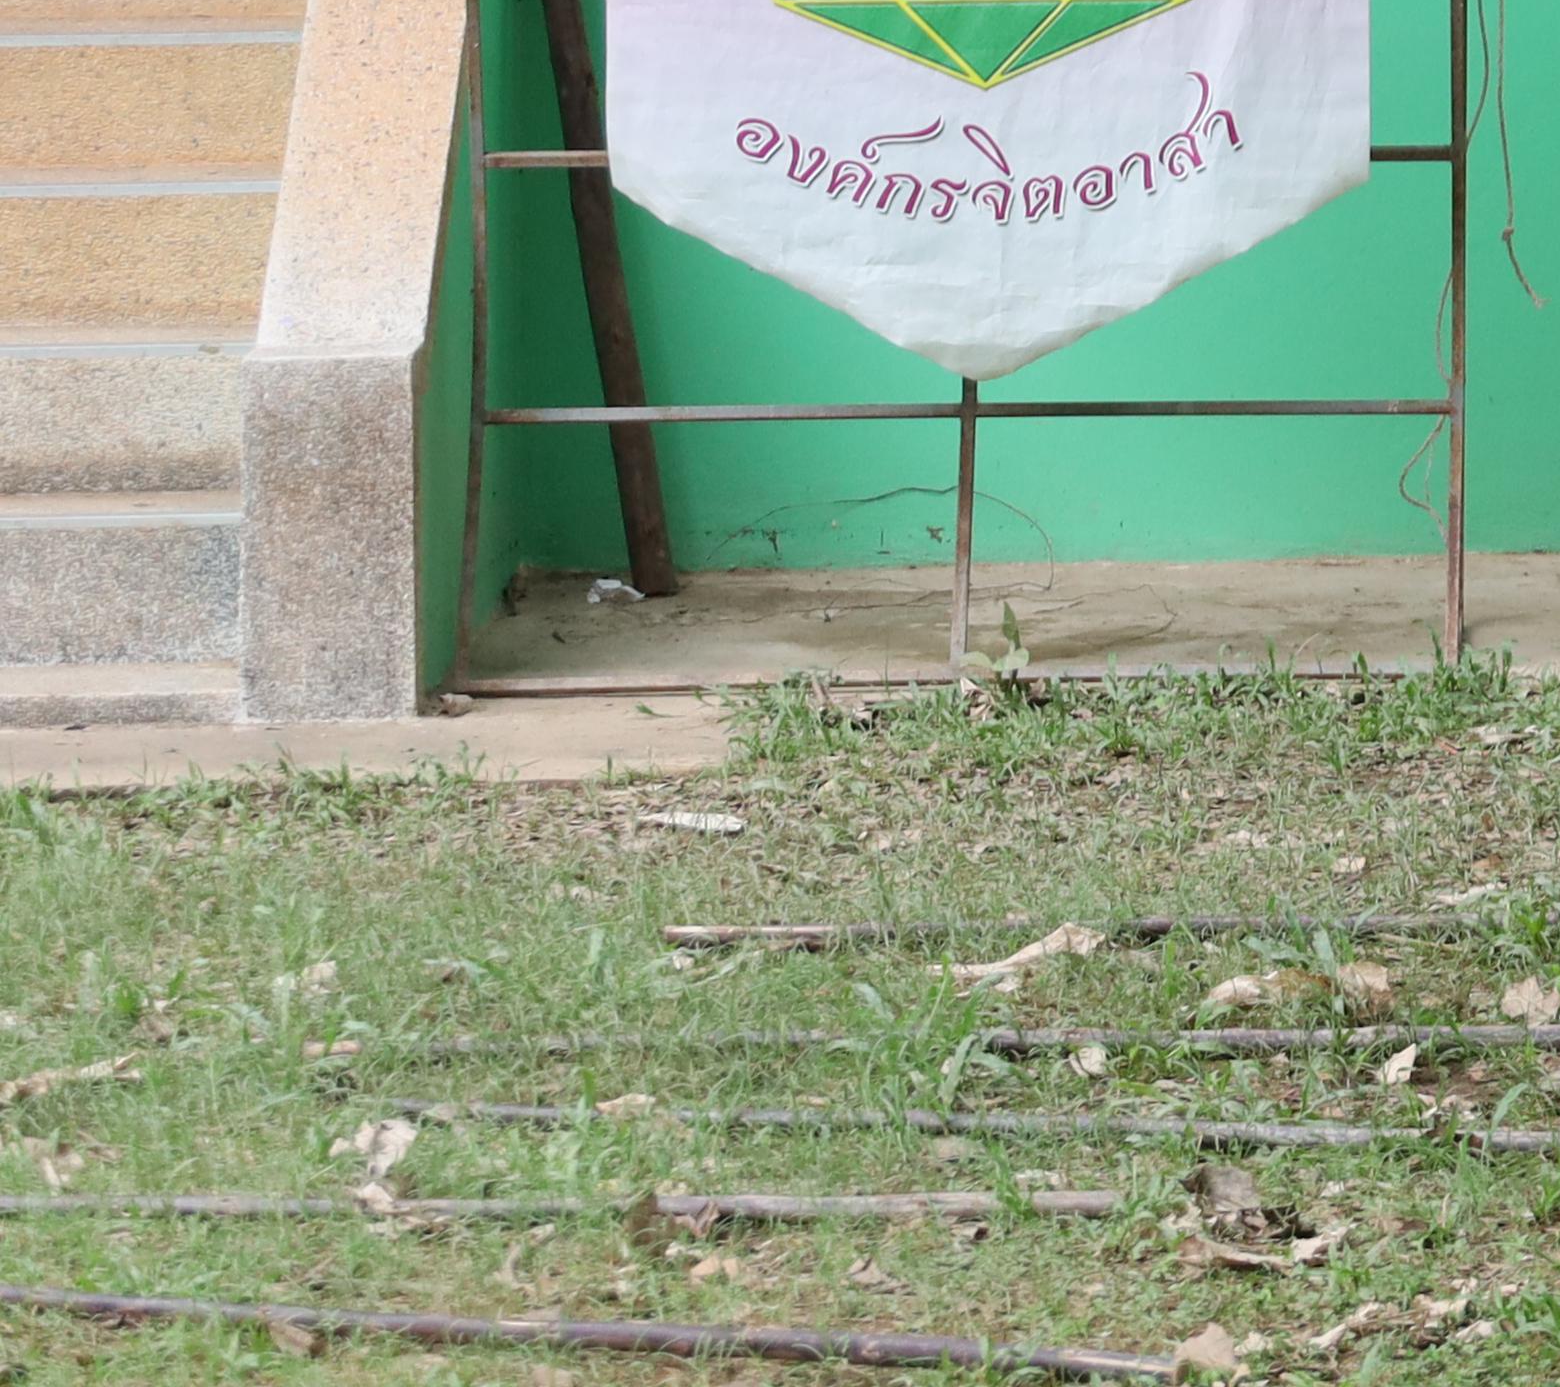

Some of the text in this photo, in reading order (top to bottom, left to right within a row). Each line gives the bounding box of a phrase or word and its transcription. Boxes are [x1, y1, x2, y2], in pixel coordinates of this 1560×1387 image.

[735, 71, 1242, 223] องค์กรจิตอาสา
